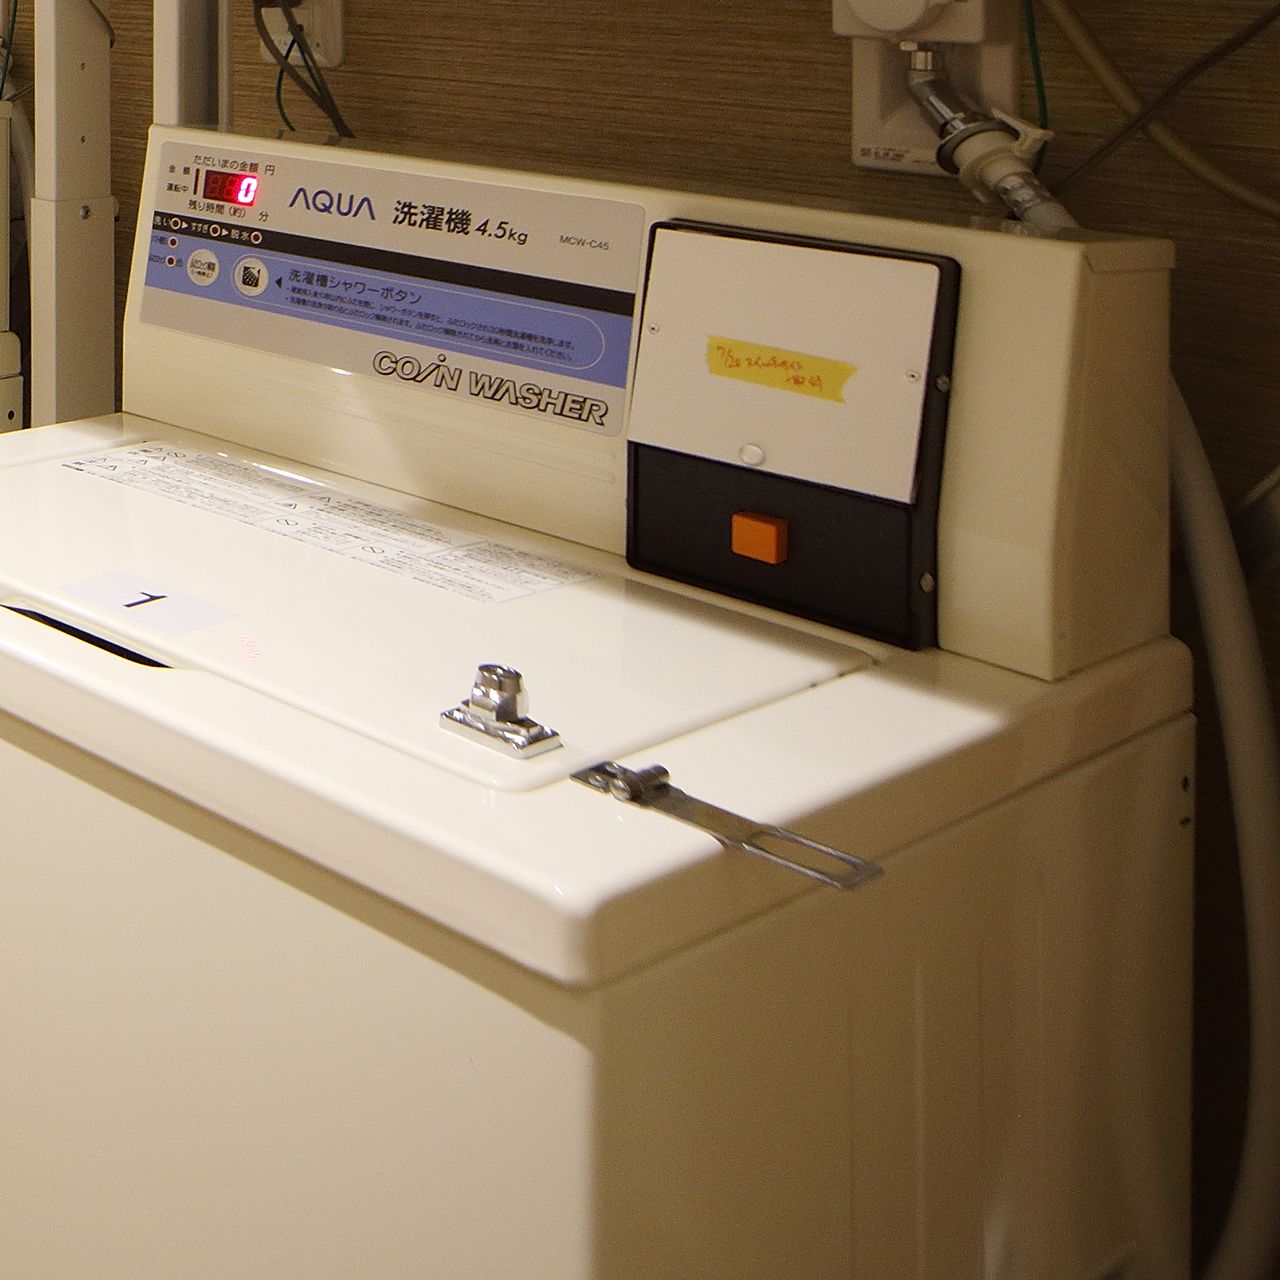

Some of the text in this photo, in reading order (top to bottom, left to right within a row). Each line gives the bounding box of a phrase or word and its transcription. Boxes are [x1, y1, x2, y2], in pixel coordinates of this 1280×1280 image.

[193, 155, 275, 176] ただいまの金額 円
[167, 183, 189, 193] 運転中
[289, 186, 376, 221] AQUA
[259, 210, 269, 223] 分
[392, 199, 473, 236] 洗濯機
[475, 218, 529, 247] 4.5kg
[559, 234, 610, 252] MCW-C45
[289, 268, 423, 305] 洗濯槽シャワーボタン
[371, 350, 610, 426] COIN WASHER
[122, 591, 169, 608] 1
